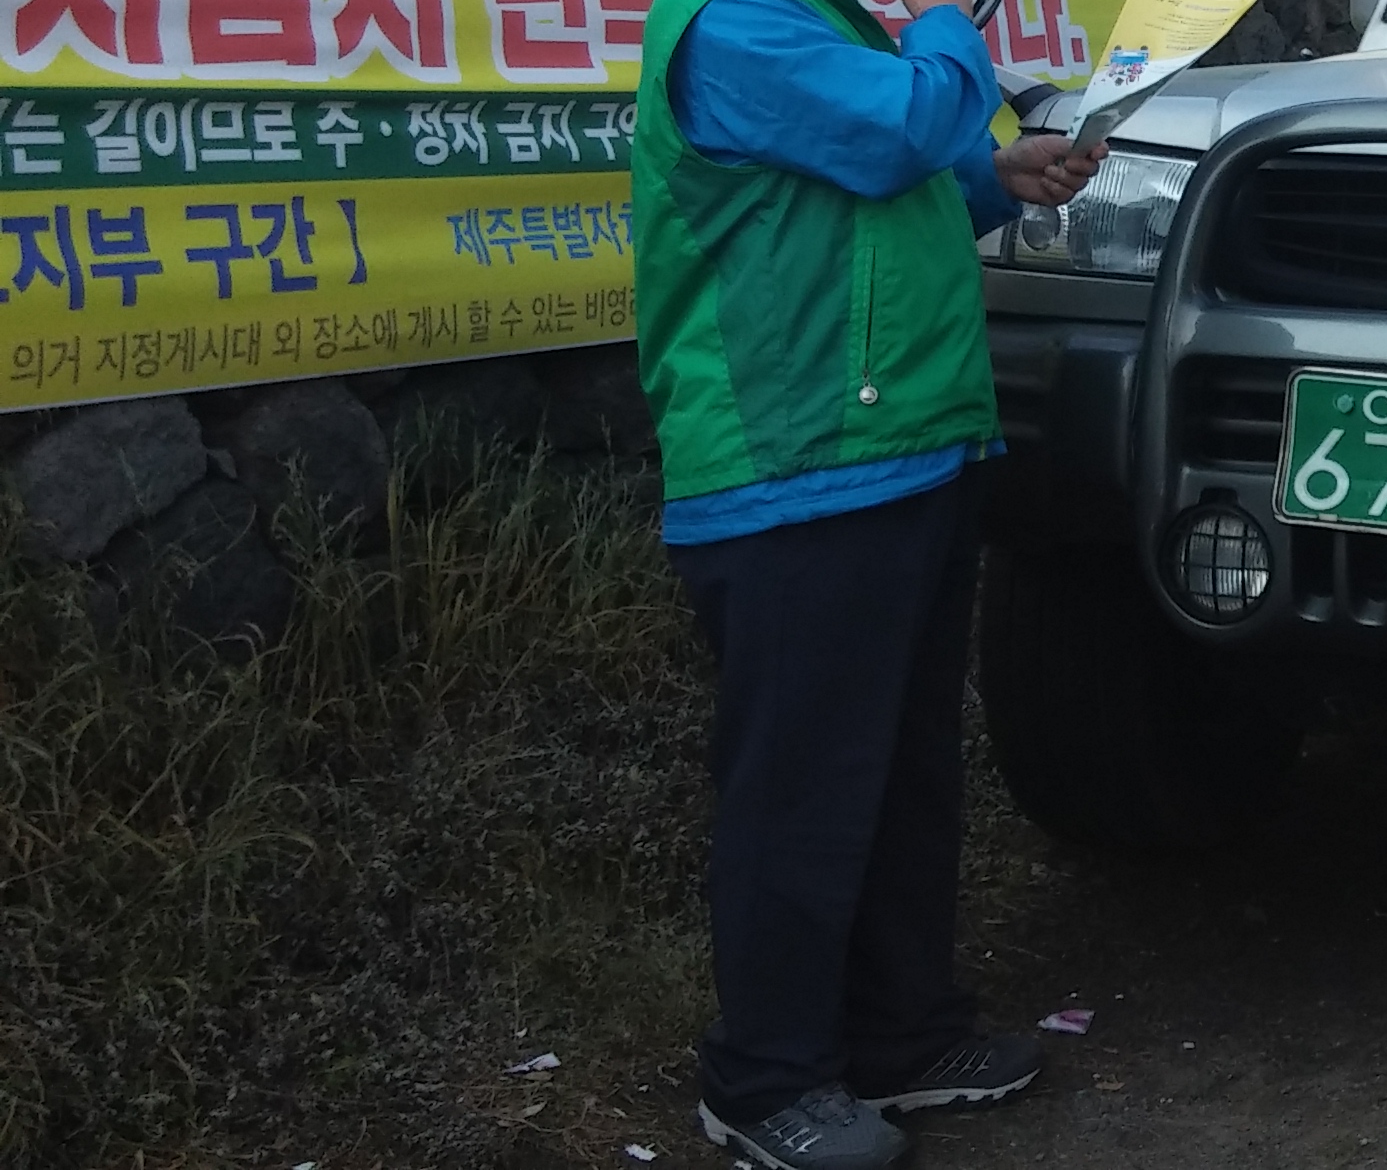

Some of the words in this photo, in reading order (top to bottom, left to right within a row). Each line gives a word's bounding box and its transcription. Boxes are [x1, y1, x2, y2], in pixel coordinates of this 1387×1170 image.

[0, 98, 65, 173] 는
[86, 98, 302, 173] 길이므로
[496, 100, 581, 163] 금지
[0, 204, 164, 312] 지부
[10, 335, 80, 390] 의거
[96, 321, 261, 380] 지정게시대
[272, 317, 301, 363] 외
[313, 307, 398, 360] 장소에
[500, 300, 524, 338] 수
[532, 292, 578, 335] 있는
[585, 286, 636, 329] 비영
